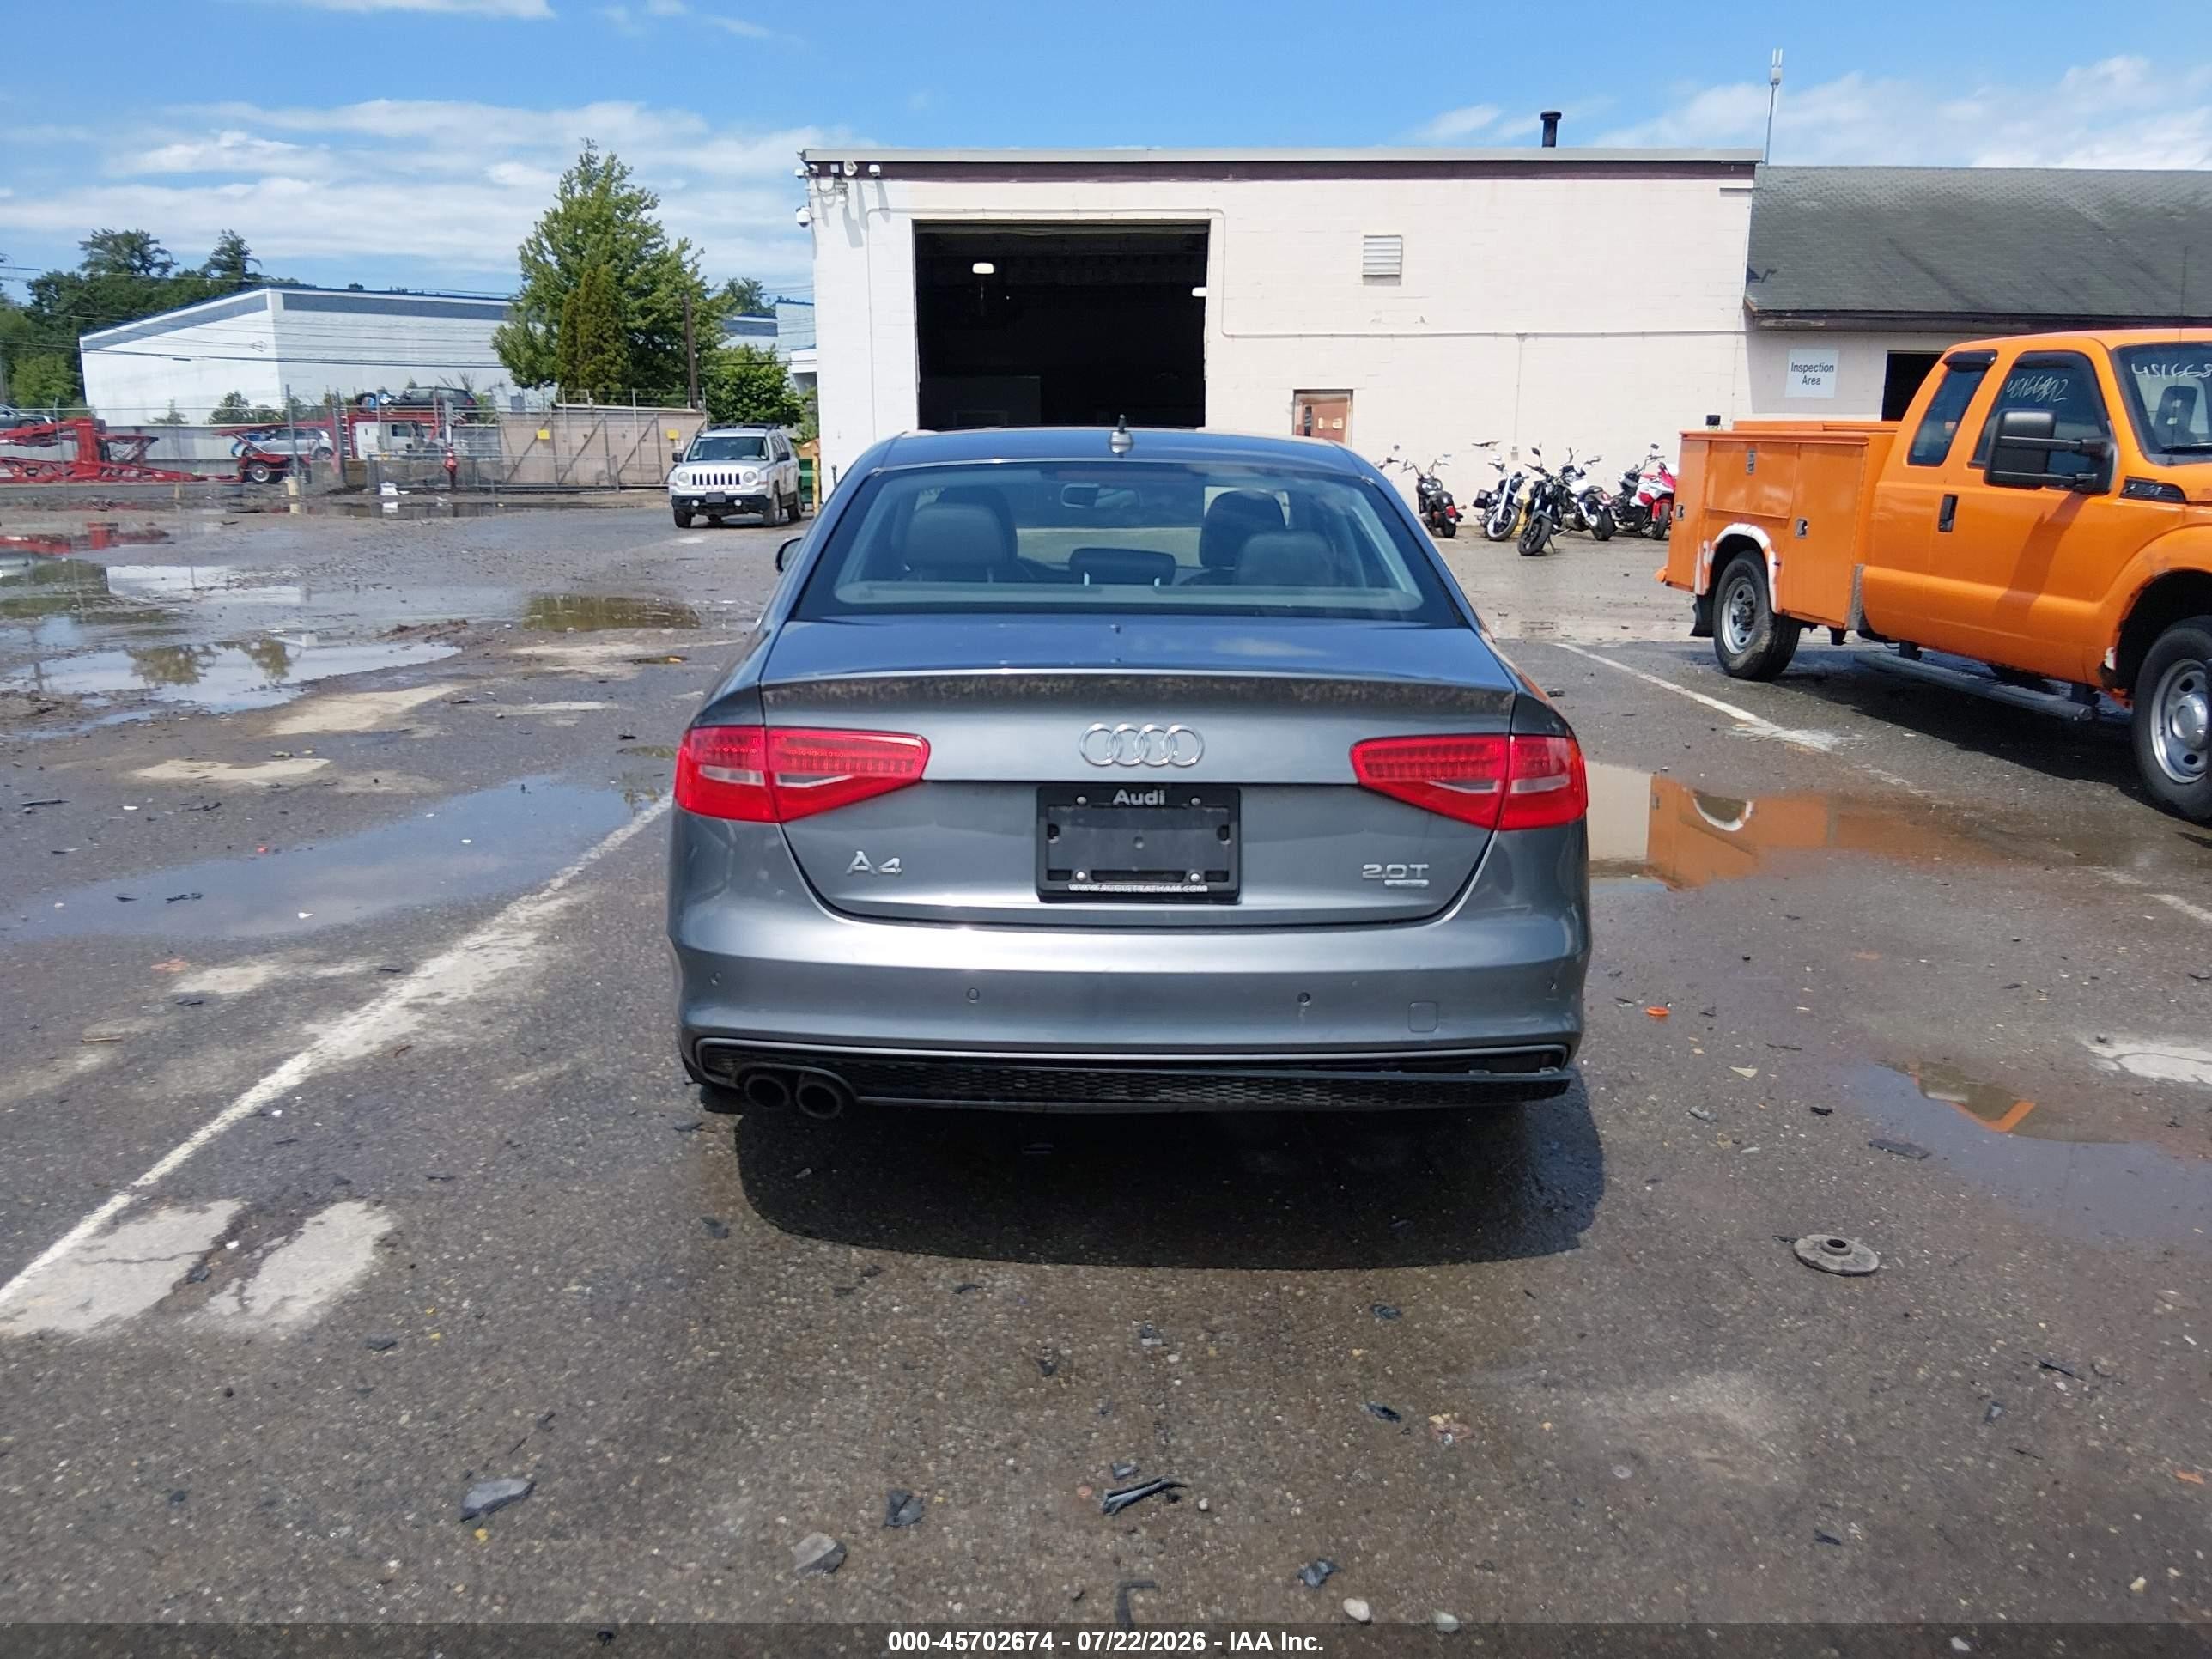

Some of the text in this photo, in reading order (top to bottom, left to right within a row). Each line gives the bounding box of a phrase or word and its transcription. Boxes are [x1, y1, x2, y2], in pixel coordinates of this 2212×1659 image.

[1791, 362, 1834, 374] Inspection
[1801, 374, 1821, 386] Area
[1113, 789, 1165, 805] Audi
[846, 850, 902, 874] A4
[1362, 864, 1429, 878] 2.0T
